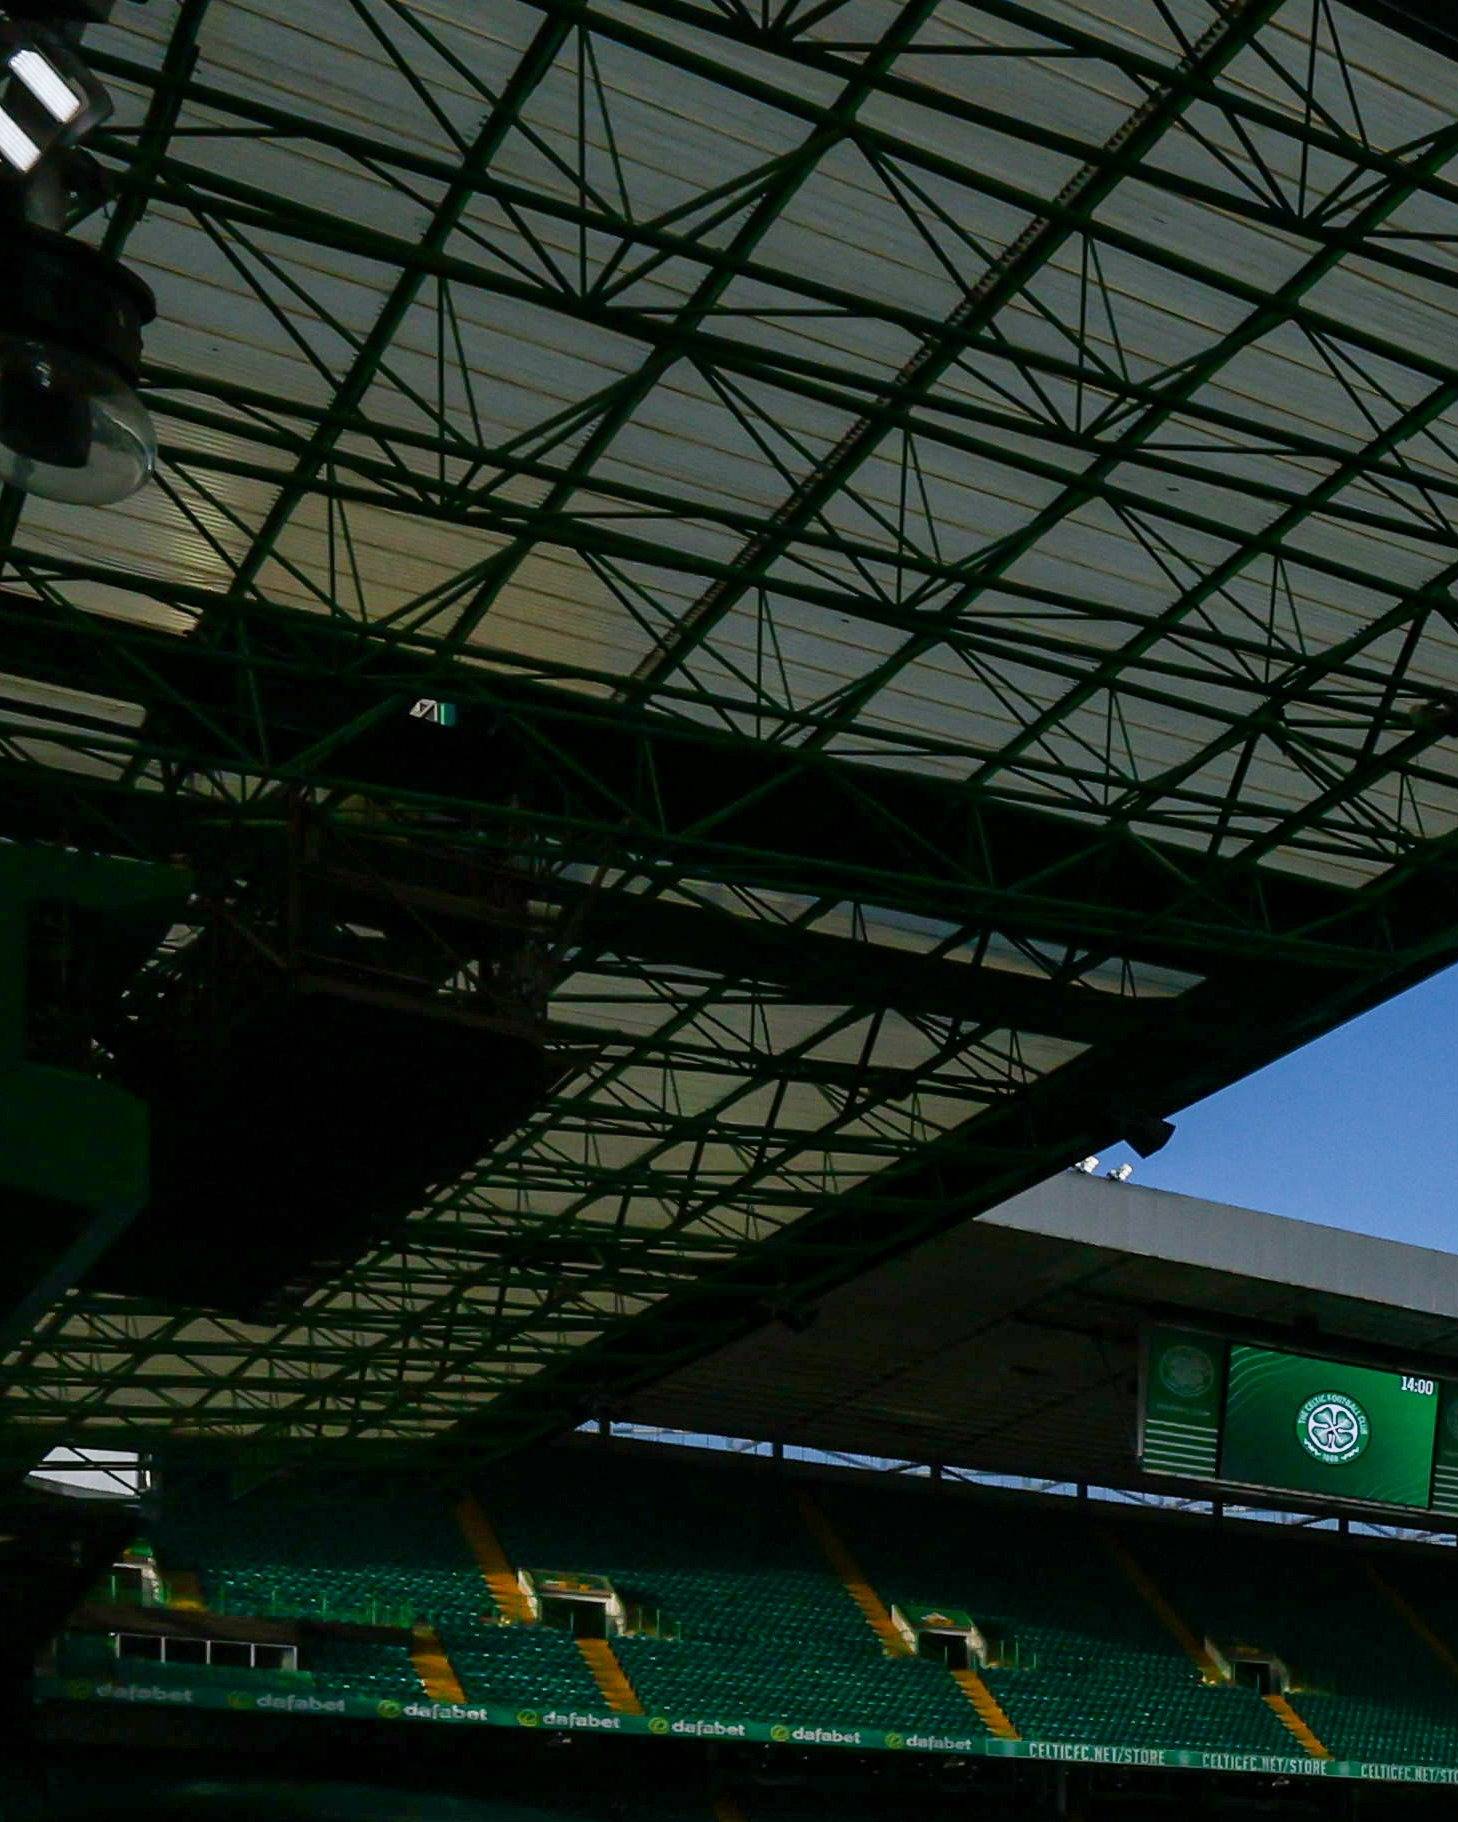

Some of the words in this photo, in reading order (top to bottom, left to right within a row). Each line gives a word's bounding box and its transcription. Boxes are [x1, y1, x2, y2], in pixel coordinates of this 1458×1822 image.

[1400, 1375, 1434, 1396] 14:00
[403, 1703, 488, 1721] dafabet
[542, 1710, 620, 1730] dafabet
[672, 1719, 745, 1738] dafabet
[792, 1727, 861, 1746] dafabet
[905, 1735, 973, 1752] dafabet
[1028, 1742, 1165, 1766] CELTICFC.NET/STORE
